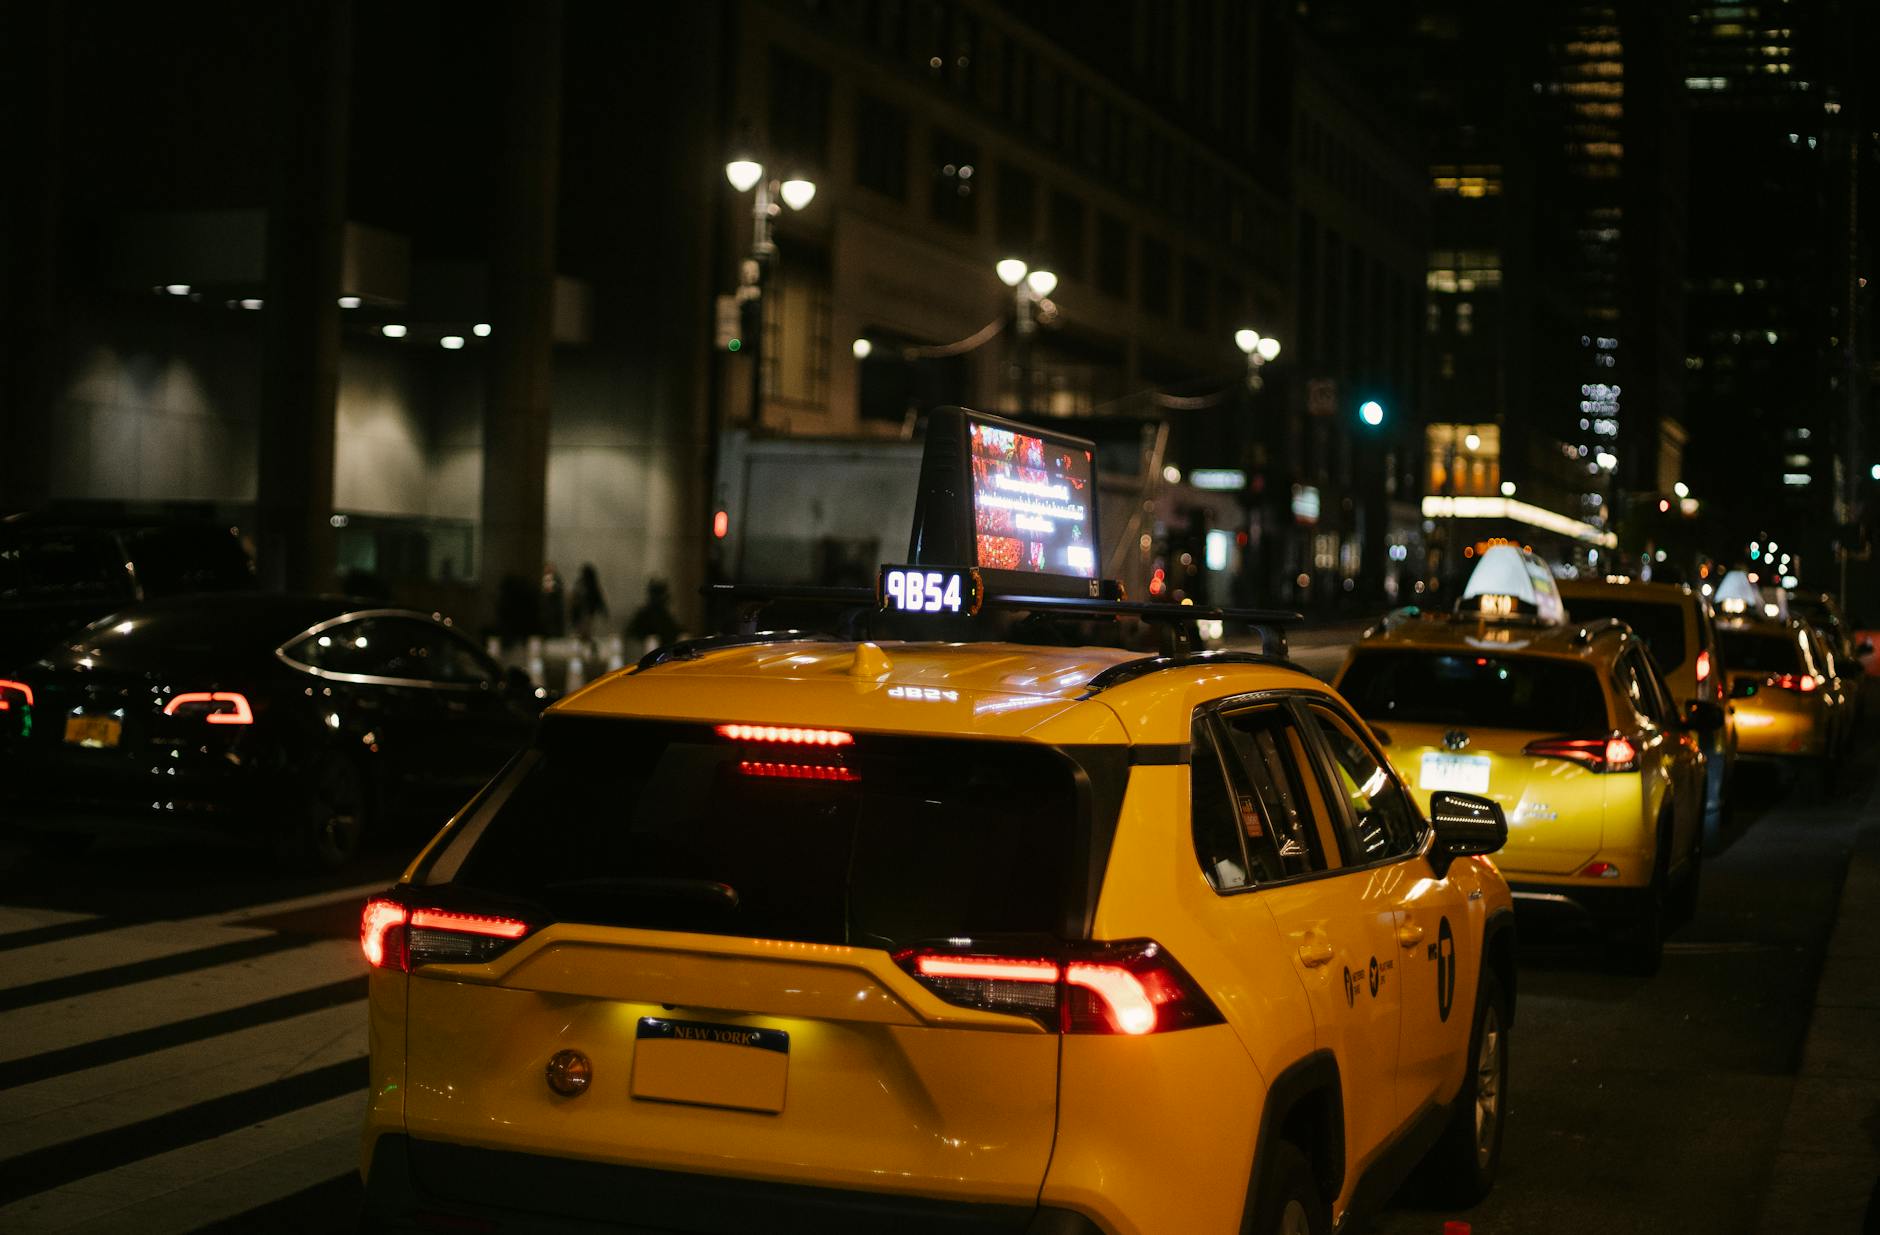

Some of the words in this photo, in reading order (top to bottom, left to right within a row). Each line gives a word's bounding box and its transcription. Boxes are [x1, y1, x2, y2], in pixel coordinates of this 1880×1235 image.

[887, 571, 962, 612] 9B54
[673, 1026, 710, 1040] NEW
[713, 1030, 753, 1045] YORK
